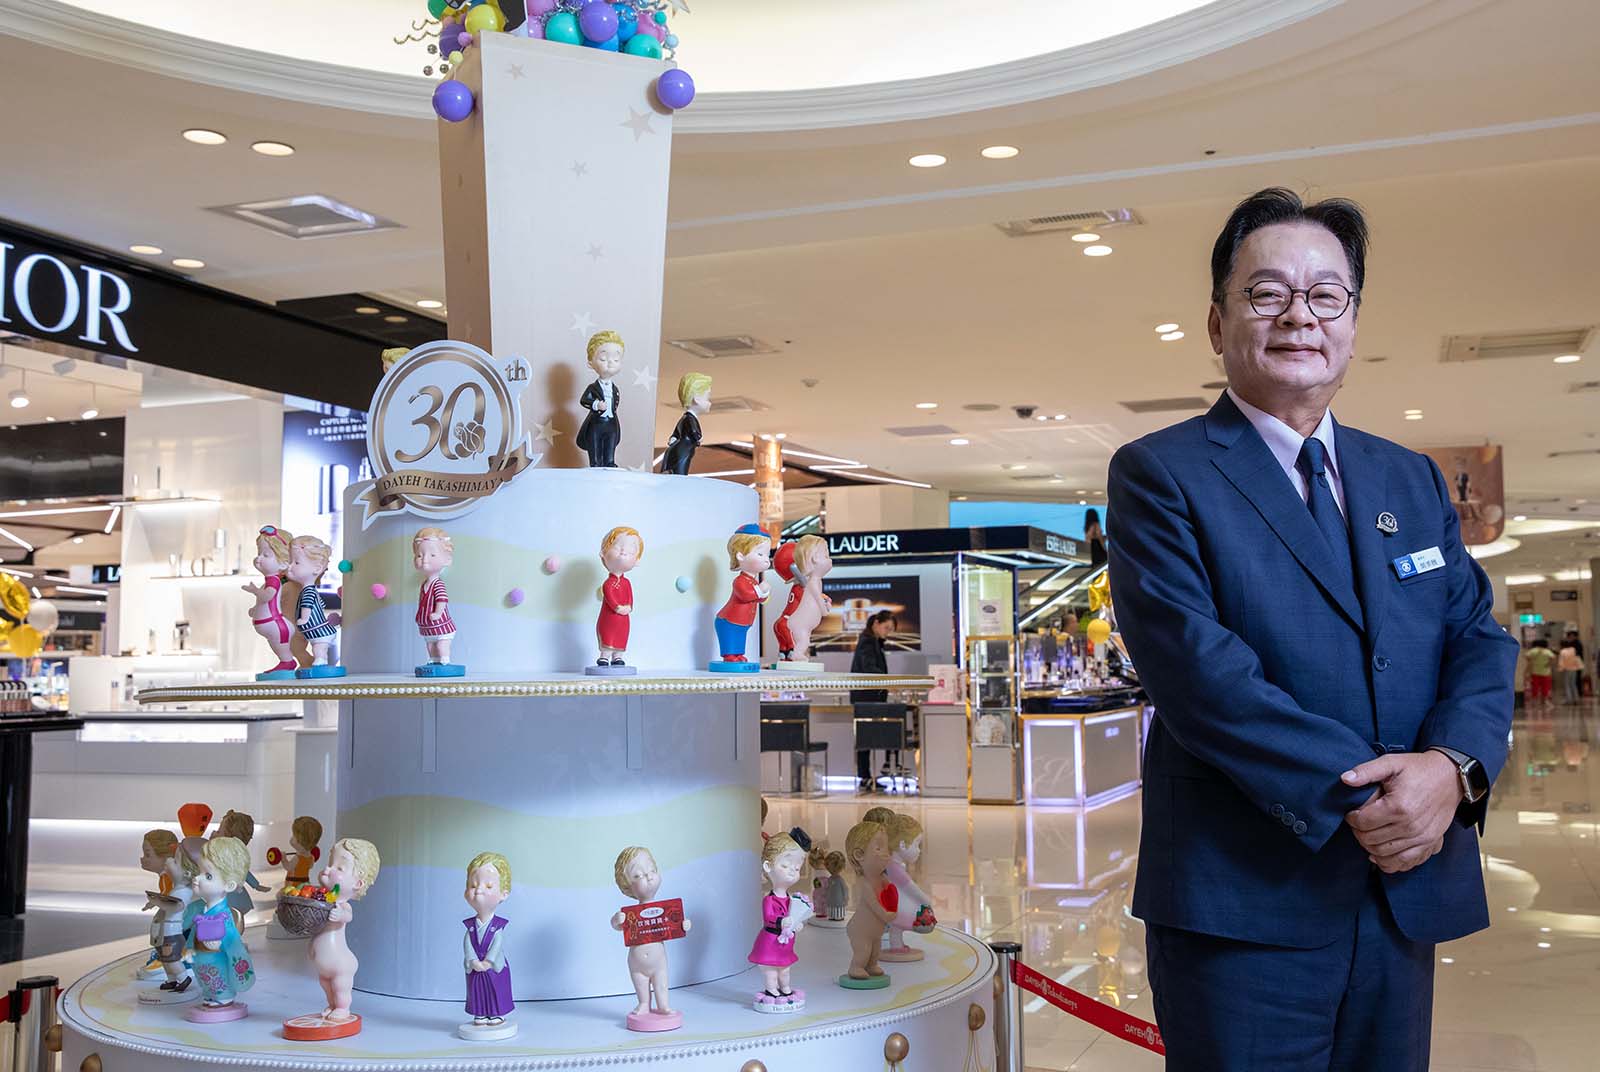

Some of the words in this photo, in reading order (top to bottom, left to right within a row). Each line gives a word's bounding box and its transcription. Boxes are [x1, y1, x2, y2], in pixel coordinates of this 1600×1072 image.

[505, 359, 527, 382] th
[395, 382, 486, 463] 30
[383, 474, 421, 491] DAYEH
[830, 534, 899, 553] LAUDER
[1124, 1023, 1147, 1039] DAYEH
